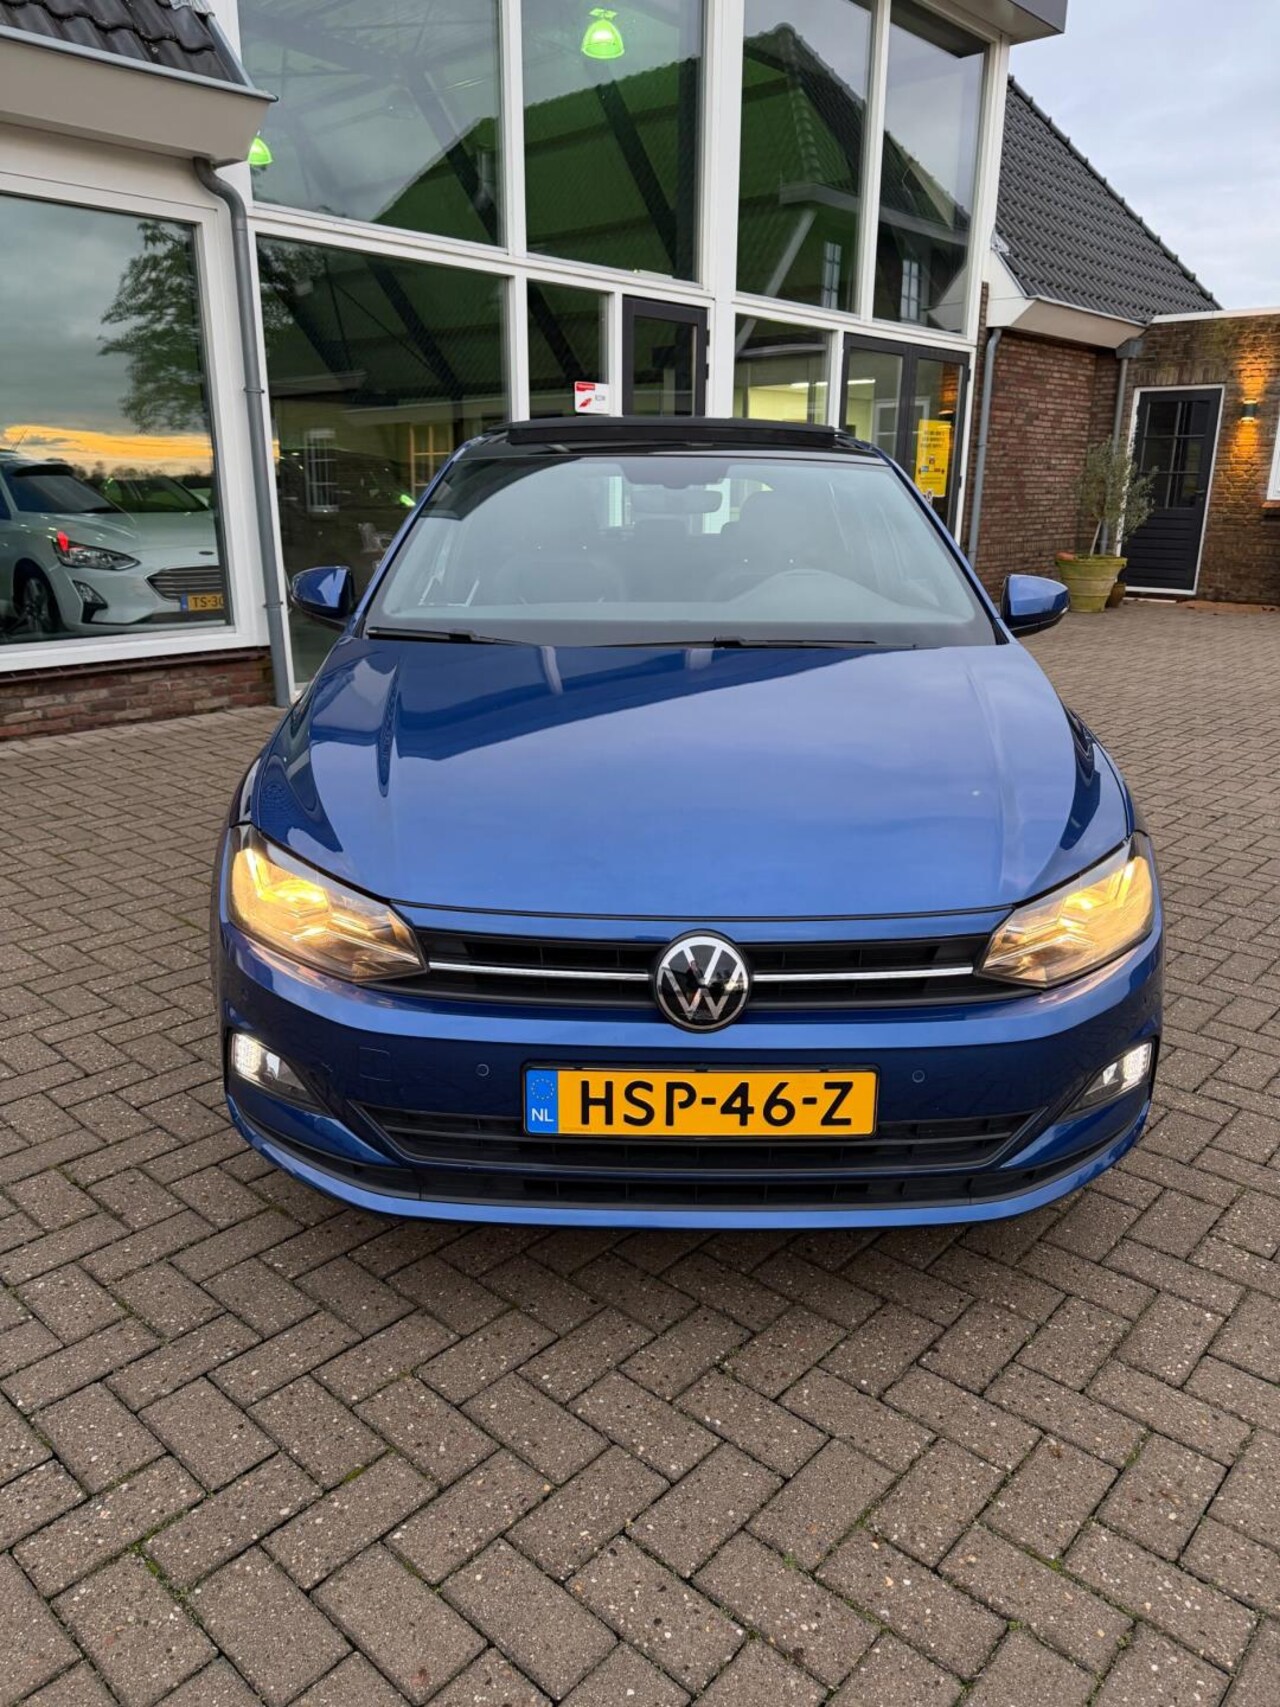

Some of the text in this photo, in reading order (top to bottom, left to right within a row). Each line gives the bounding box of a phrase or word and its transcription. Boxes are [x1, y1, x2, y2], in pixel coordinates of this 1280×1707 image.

[657, 936, 748, 1030] VW
[531, 1107, 554, 1122] NL
[580, 1080, 854, 1127] HSP-46-Z
